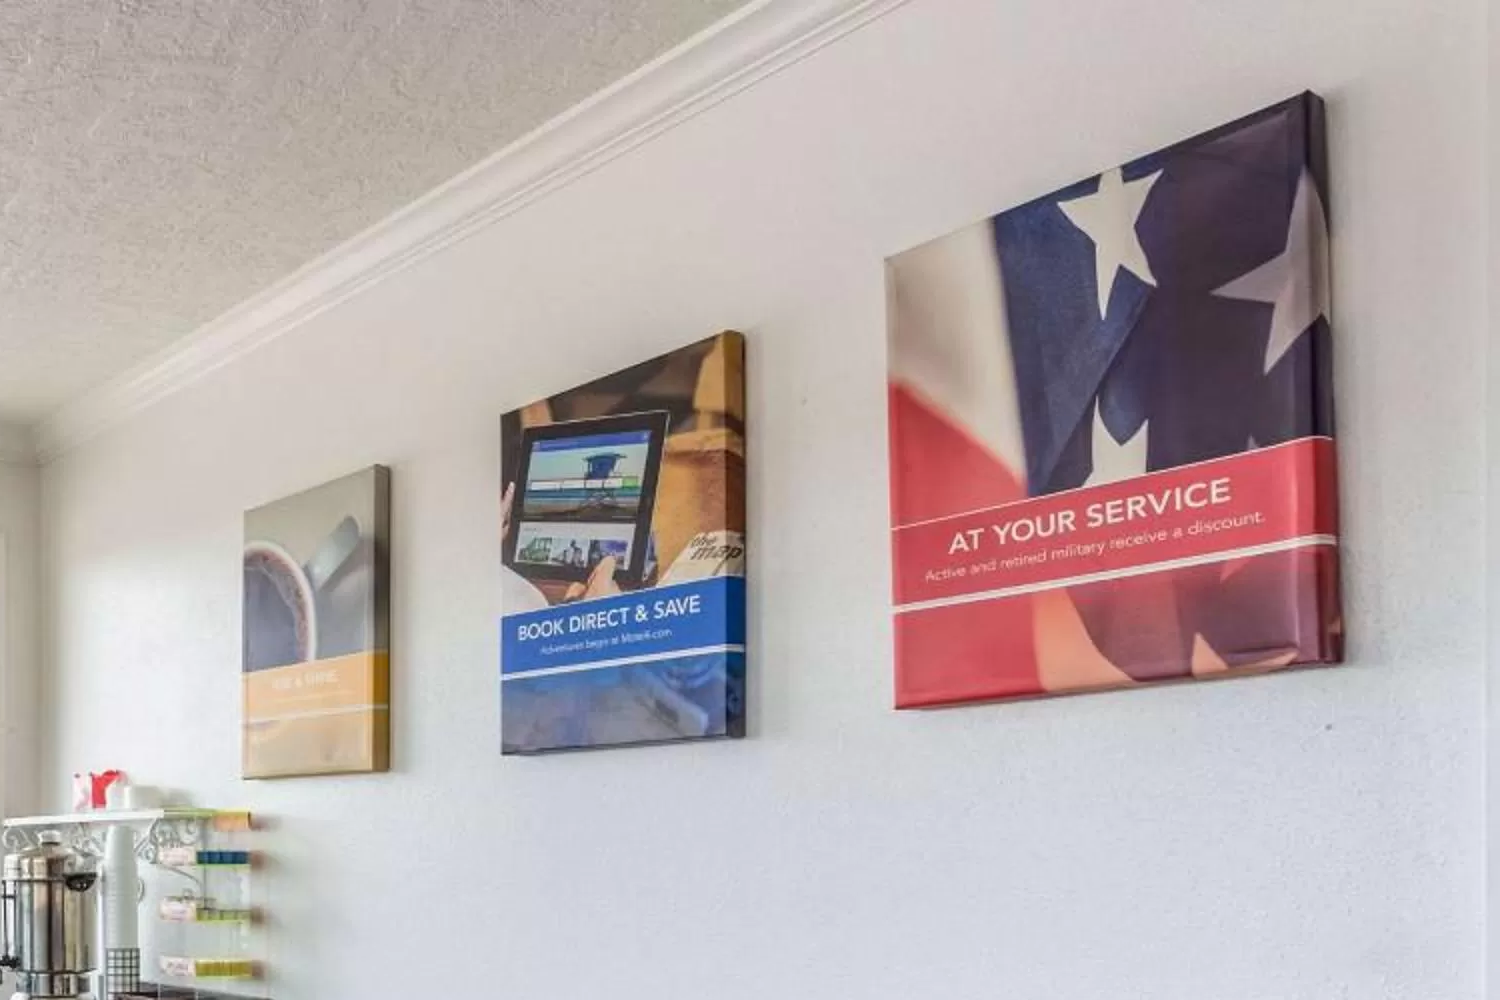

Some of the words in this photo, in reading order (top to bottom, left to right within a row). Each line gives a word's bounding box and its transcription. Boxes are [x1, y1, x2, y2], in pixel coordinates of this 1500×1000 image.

[925, 565, 967, 583] Active
[970, 558, 997, 575] and
[1000, 549, 1047, 569] retired
[1051, 540, 1106, 561] military
[1110, 529, 1168, 549] receive
[1171, 526, 1184, 538] a
[1187, 511, 1266, 535] discount.
[947, 527, 985, 555] AT
[991, 509, 1077, 545] YOUR
[1085, 476, 1232, 528] SERVICE
[517, 619, 565, 641] BOOK
[569, 607, 631, 633] DIRECT
[635, 604, 649, 622] &
[653, 594, 701, 619] SAVE
